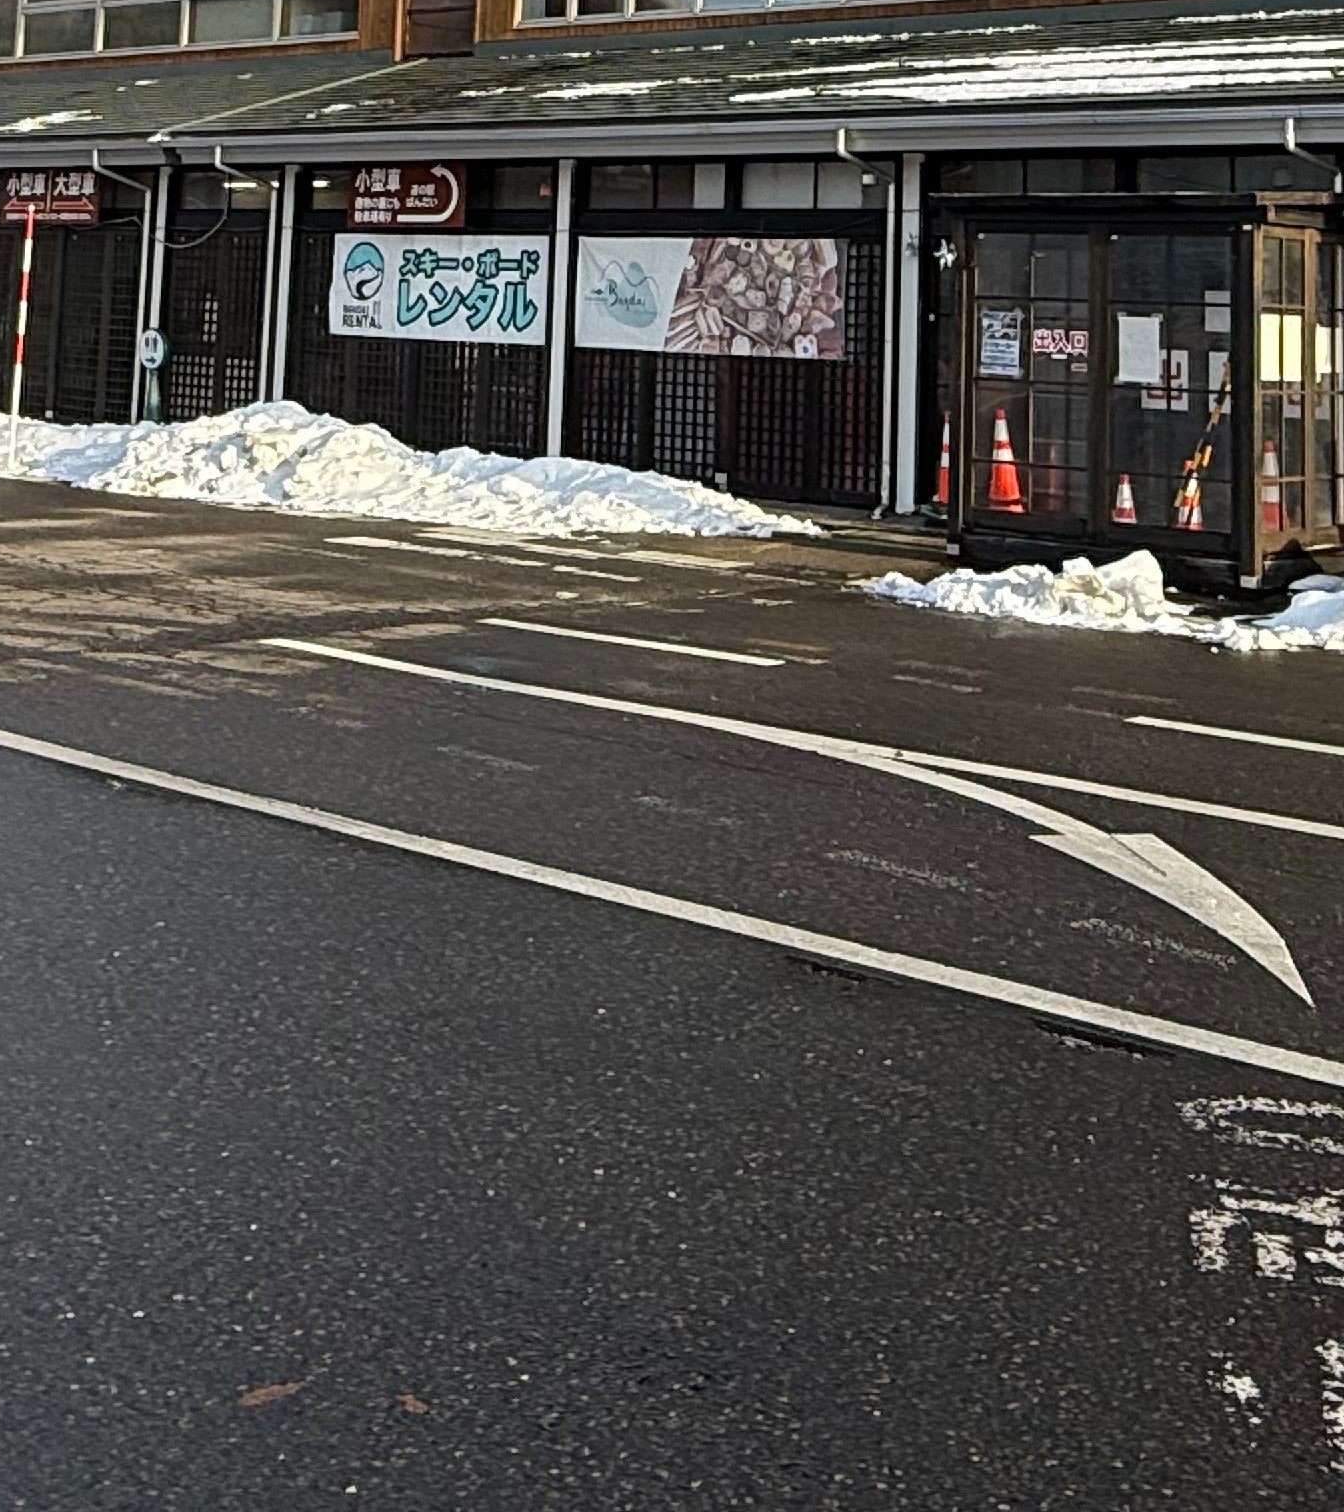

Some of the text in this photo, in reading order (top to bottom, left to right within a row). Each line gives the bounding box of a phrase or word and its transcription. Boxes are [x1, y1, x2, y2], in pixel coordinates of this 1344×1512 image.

[7, 172, 46, 196] 小型車
[53, 172, 95, 196] 大型車
[355, 168, 402, 193] 小型車
[399, 248, 540, 279] スキー・ボード
[396, 278, 539, 332] レンタル
[342, 314, 383, 329] RENTAL
[1033, 329, 1089, 355] 出入口
